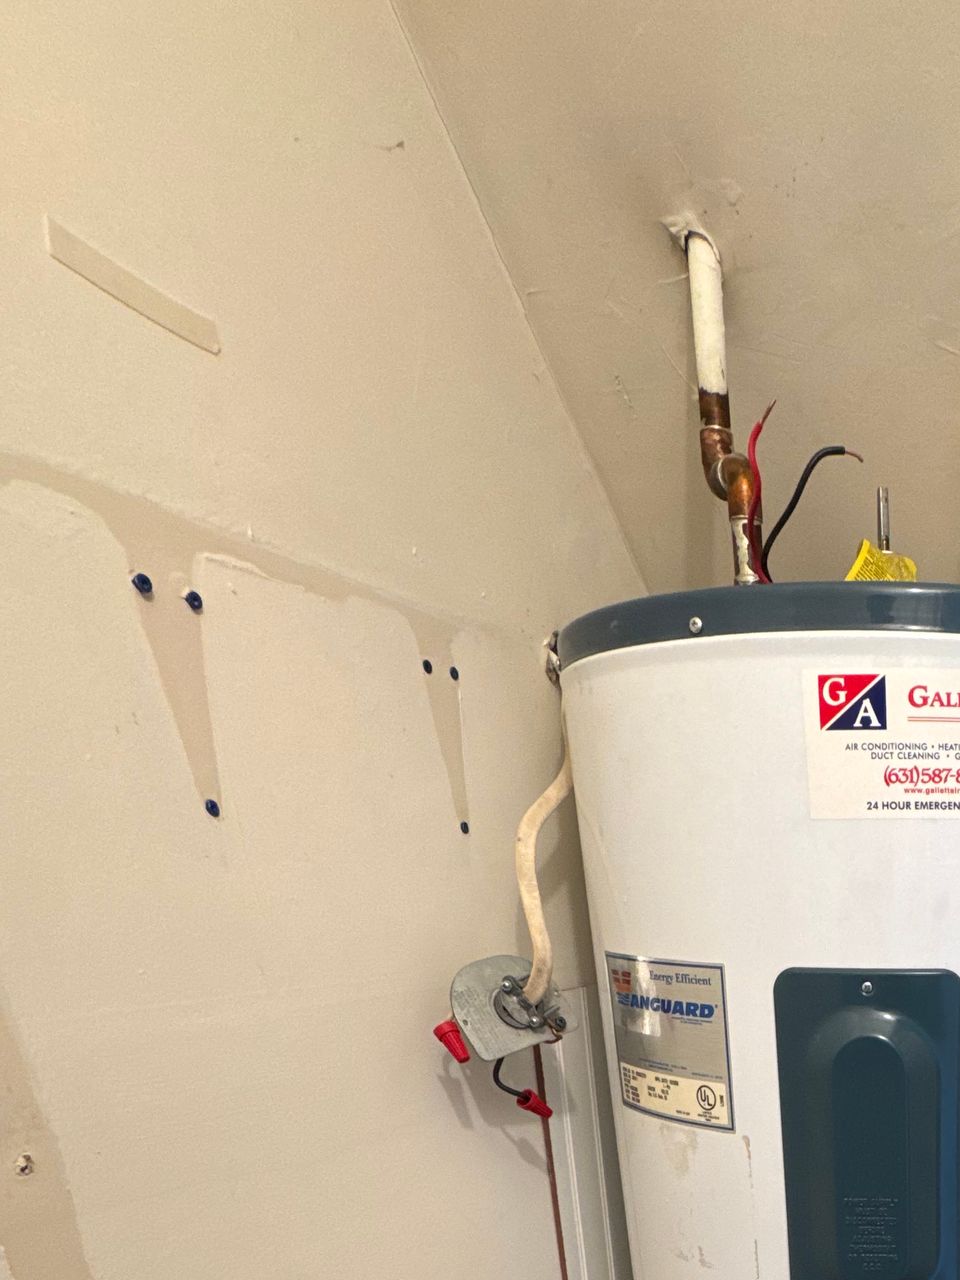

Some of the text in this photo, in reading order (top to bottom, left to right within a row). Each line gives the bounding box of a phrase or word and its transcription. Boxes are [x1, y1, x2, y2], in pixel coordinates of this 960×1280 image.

[822, 677, 882, 728] G A
[845, 742, 859, 750] AIR
[861, 742, 928, 751] CONDITIONING
[871, 752, 894, 760] DUCT
[897, 752, 940, 760] CLEANING
[866, 801, 879, 810] 24
[881, 801, 911, 811] HOUR
[650, 970, 712, 986] Energy Efficient
